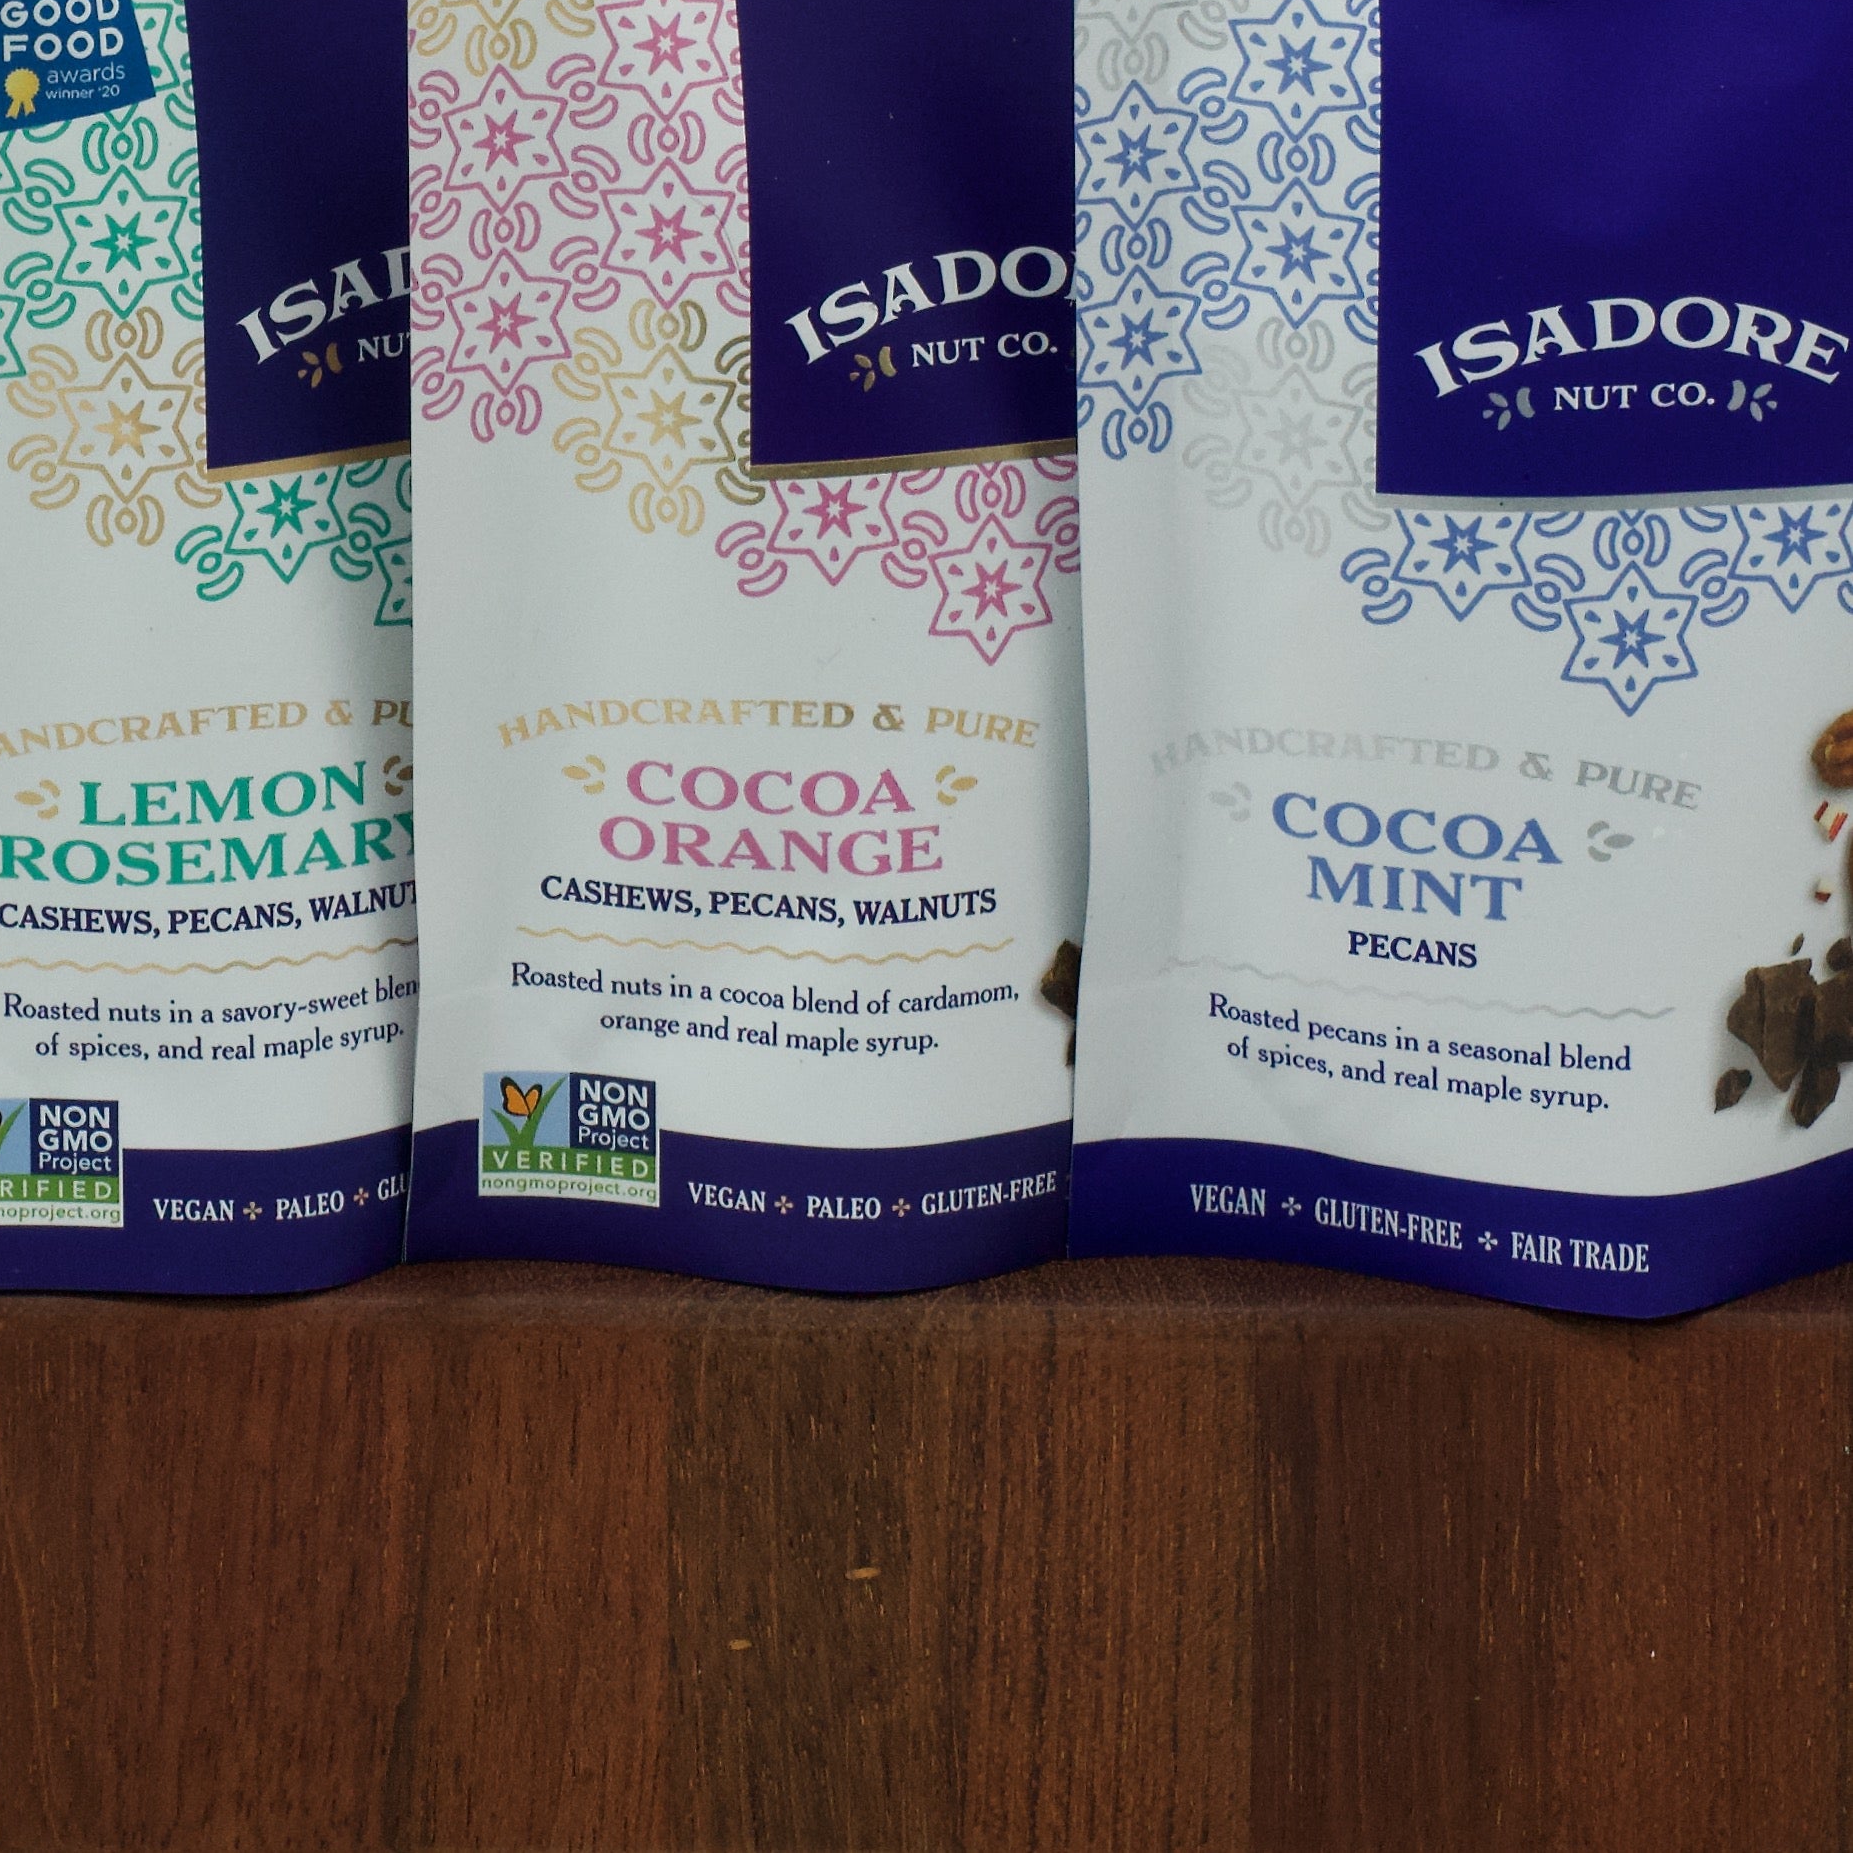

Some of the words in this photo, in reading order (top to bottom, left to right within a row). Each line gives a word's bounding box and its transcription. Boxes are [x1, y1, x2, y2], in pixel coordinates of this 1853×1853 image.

[4, 27, 123, 61] FOOD
[47, 62, 125, 83] awards
[45, 90, 93, 99] winner
[785, 246, 1072, 365] ISADO
[912, 337, 984, 367] NUT
[998, 332, 1057, 357] CO.
[1414, 297, 1849, 398] ISADORE
[1554, 385, 1637, 410] NUT
[1651, 382, 1714, 407] CO.
[324, 699, 353, 726] &
[497, 699, 854, 749] HANDCRAFTED
[872, 702, 904, 731] &
[926, 708, 1042, 749] PURE
[1150, 727, 1500, 776] HANDCRAFTED
[1519, 751, 1554, 781] &
[1576, 760, 1701, 810] PURE
[79, 760, 368, 828] LEMON
[627, 761, 915, 817] COCOA
[600, 817, 942, 876] ORANGE
[1272, 793, 1562, 865] COCOA
[541, 876, 701, 917] CASHEWS,
[709, 891, 844, 928] PECANS,
[853, 888, 996, 925] WALNUTS
[1307, 856, 1522, 921] MINT
[168, 902, 301, 934] PECANS,
[1348, 931, 1477, 968] PECANS
[512, 962, 603, 992] Roasted
[611, 978, 661, 995] nuts
[669, 976, 692, 1000] in
[701, 986, 711, 1000] a
[720, 988, 784, 1009] cocoa
[793, 986, 858, 1014] blend
[867, 989, 890, 1014] of
[899, 985, 1018, 1013] cardamom,
[600, 1015, 679, 1037] orange
[687, 1016, 728, 1040] and
[738, 1021, 777, 1046] real
[786, 1027, 858, 1056] maple
[866, 1035, 938, 1056] syrup.
[1210, 993, 1300, 1032] Roasted
[1308, 1022, 1386, 1047] pecans
[1394, 1026, 1420, 1051] in
[1427, 1037, 1440, 1054] a
[1449, 1035, 1550, 1066] seasonal
[1561, 1043, 1630, 1070] blend
[579, 1079, 648, 1107] NON
[39, 1105, 110, 1128] NON
[578, 1104, 650, 1130] GMO
[39, 1128, 113, 1152] GMO
[579, 1126, 649, 1151] Project
[39, 1152, 111, 1175] Project
[492, 1150, 649, 1179] VERIFIED
[154, 1199, 233, 1221] VEGAN
[276, 1191, 344, 1220] PALEO
[481, 1176, 657, 1203] nongmoproject.org
[689, 1182, 765, 1212] VEGAN
[808, 1196, 880, 1219] PALEO
[922, 1171, 1056, 1215] GLUTEN-FREE
[1191, 1184, 1265, 1216] VEGAN
[1315, 1197, 1462, 1249] GLUTEN-FREE
[1512, 1232, 1562, 1265] FAIR
[1570, 1239, 1648, 1272] TRADE
